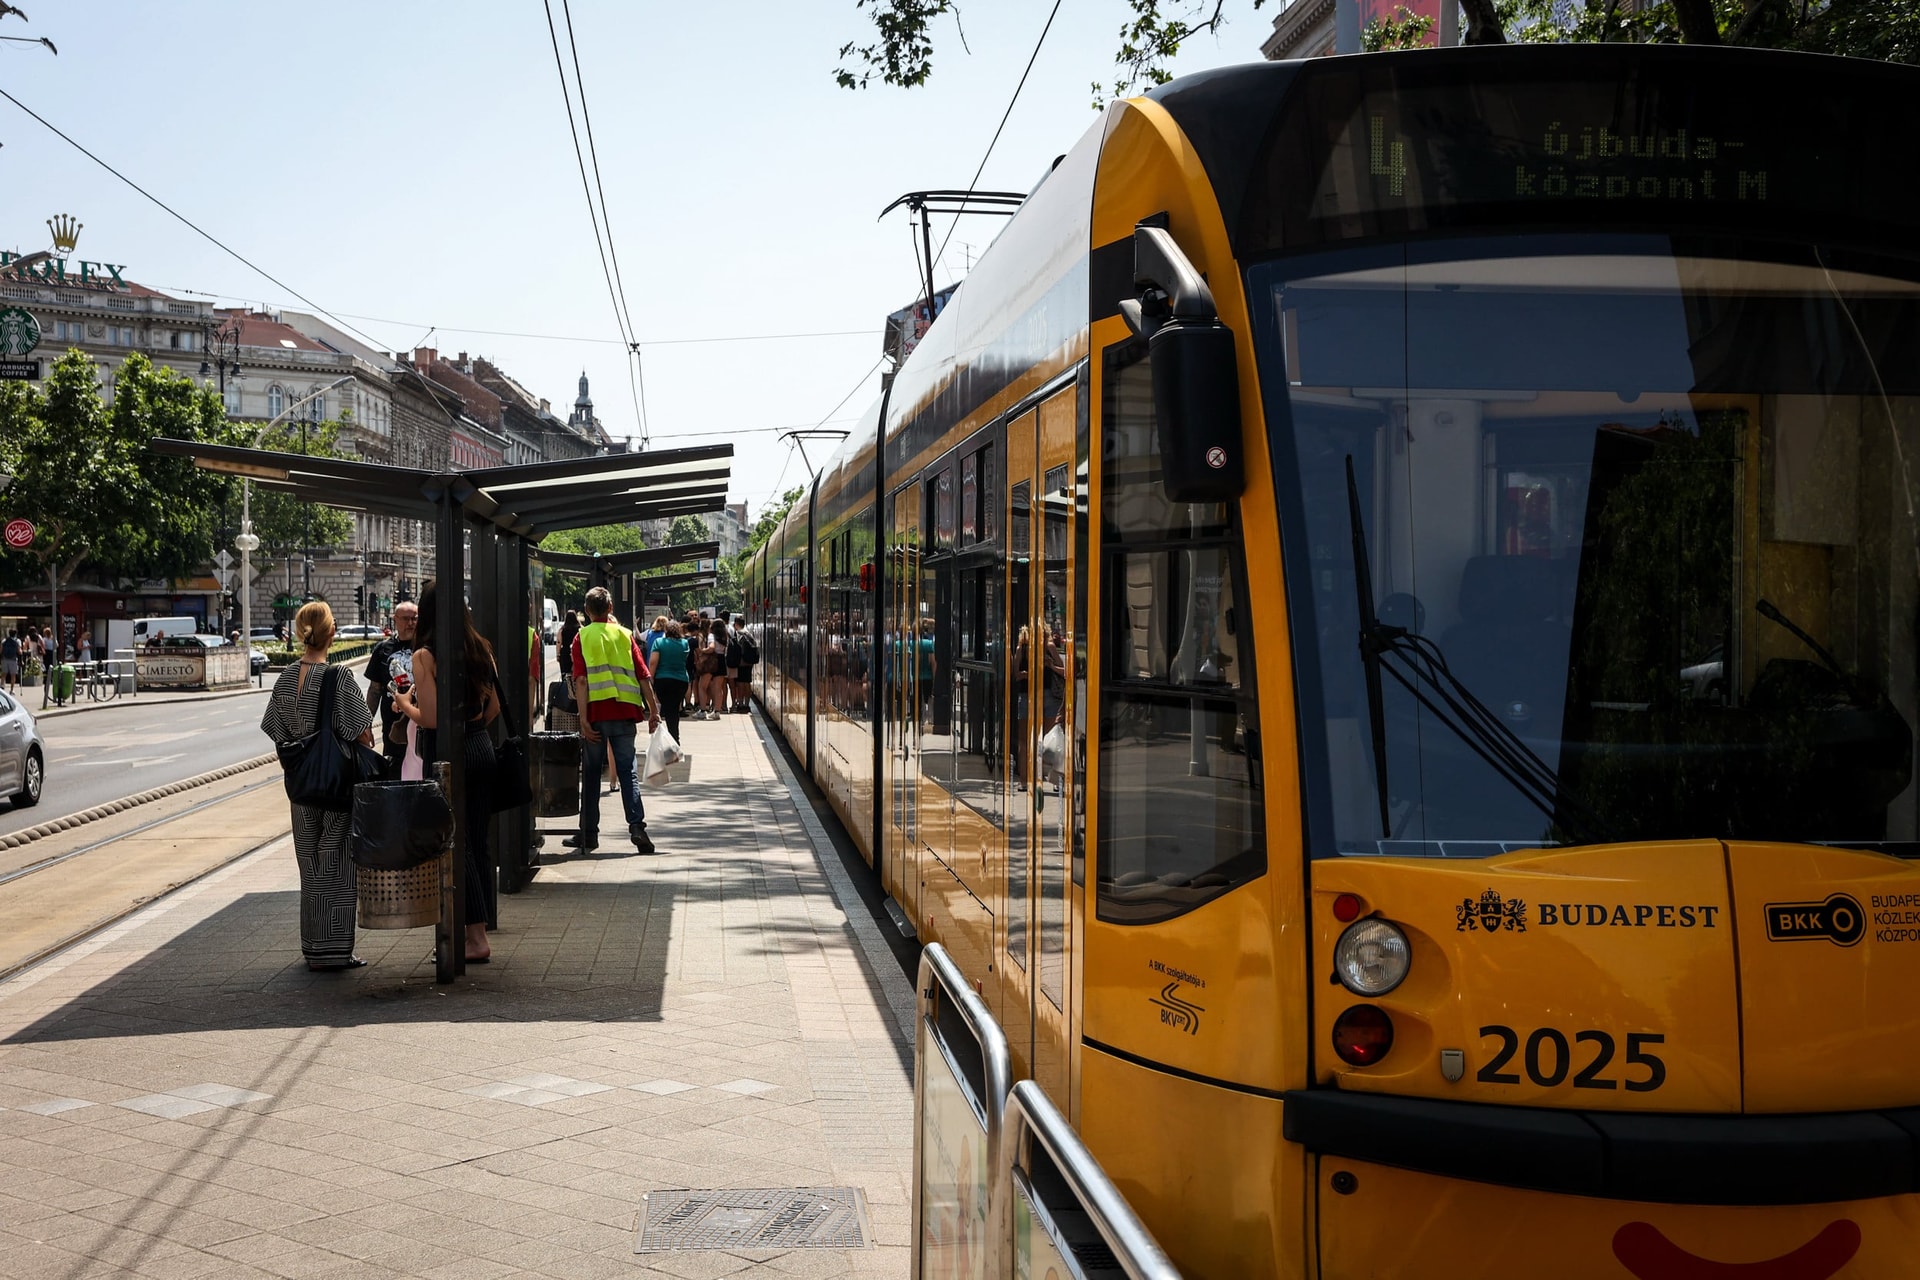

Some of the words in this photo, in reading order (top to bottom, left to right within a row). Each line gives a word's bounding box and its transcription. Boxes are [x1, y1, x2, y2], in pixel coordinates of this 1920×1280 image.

[1370, 115, 1407, 197] 4
[1515, 165, 1718, 200] központ
[1738, 170, 1768, 200] M
[1871, 894, 1920, 907] BUDAPE
[1538, 904, 1719, 928] BUDAPEST
[1779, 913, 1823, 930] BKK
[1876, 927, 1920, 942] KÖZPO
[1154, 960, 1166, 973] BKK
[923, 988, 934, 999] 10
[1476, 1024, 1667, 1092] 2025
